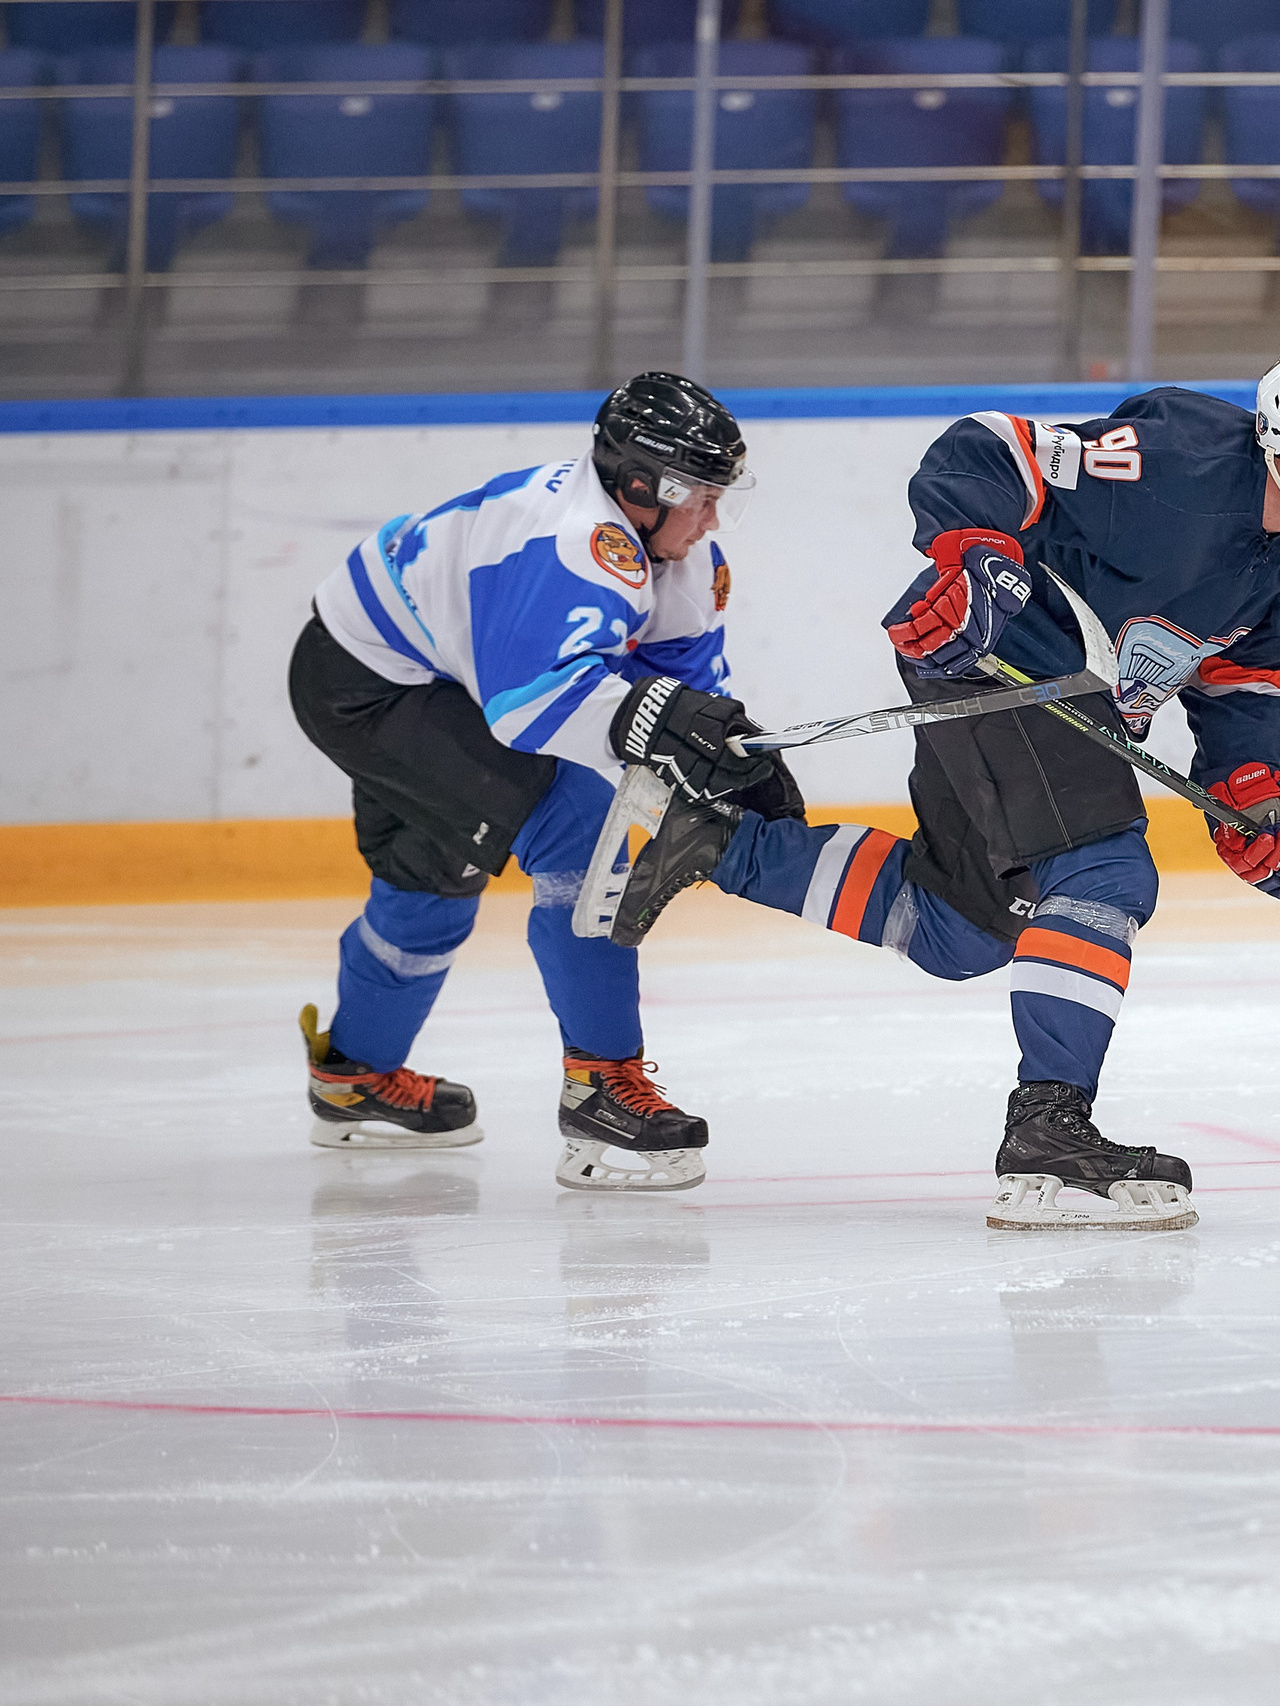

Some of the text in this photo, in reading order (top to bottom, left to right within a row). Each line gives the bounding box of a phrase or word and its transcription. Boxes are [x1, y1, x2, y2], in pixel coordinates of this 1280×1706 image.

[634, 435, 676, 453] BAUER
[869, 697, 983, 732] STEALTH
[1044, 703, 1090, 733] WARRIOR
[1098, 725, 1173, 778] ALPHA
[1235, 768, 1266, 785] BAUER
